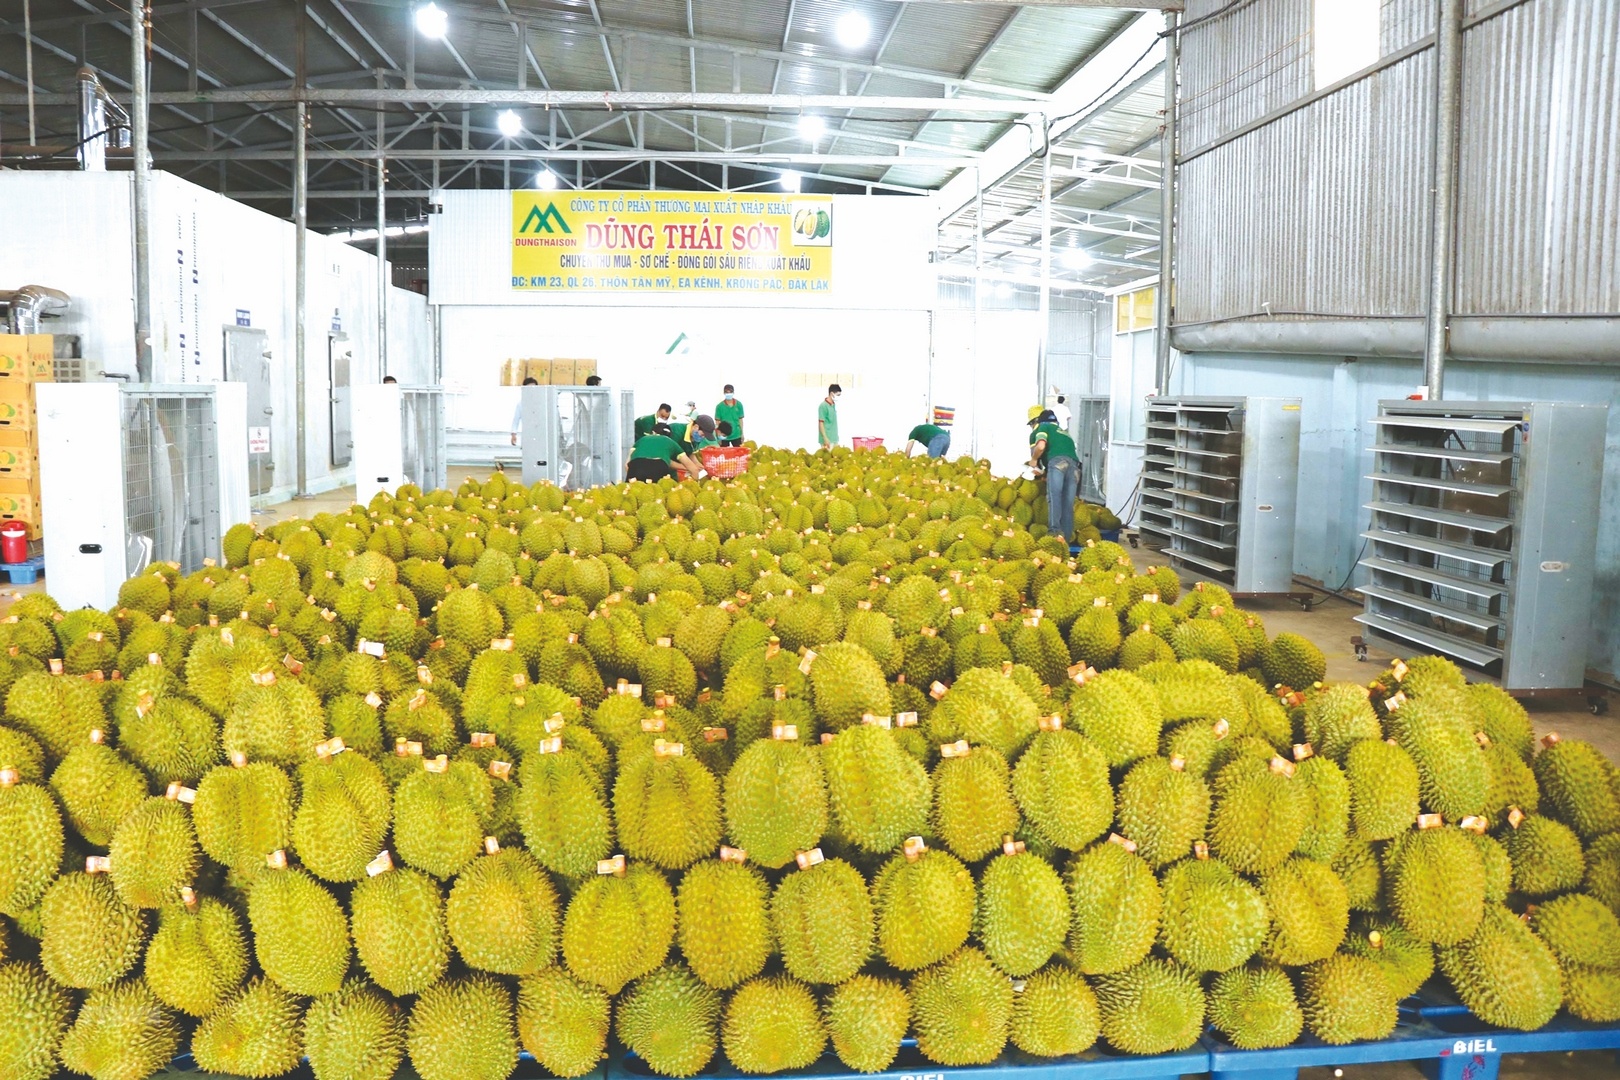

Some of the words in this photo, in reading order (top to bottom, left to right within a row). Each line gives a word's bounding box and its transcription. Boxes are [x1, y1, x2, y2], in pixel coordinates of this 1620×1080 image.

[570, 197, 595, 212] CÔNG
[598, 200, 609, 212] TY
[586, 217, 655, 249] DŨNG
[663, 218, 723, 250] THÁI
[732, 222, 779, 250] SƠN
[515, 238, 577, 247] DUNGTHAISON
[613, 254, 631, 268] MUA
[653, 251, 670, 268] CHẾ
[512, 276, 528, 287] ĐC:
[530, 276, 546, 287] KM
[567, 276, 579, 288] QL
[678, 277, 691, 288] EA
[1453, 1038, 1497, 1054] BIEL
